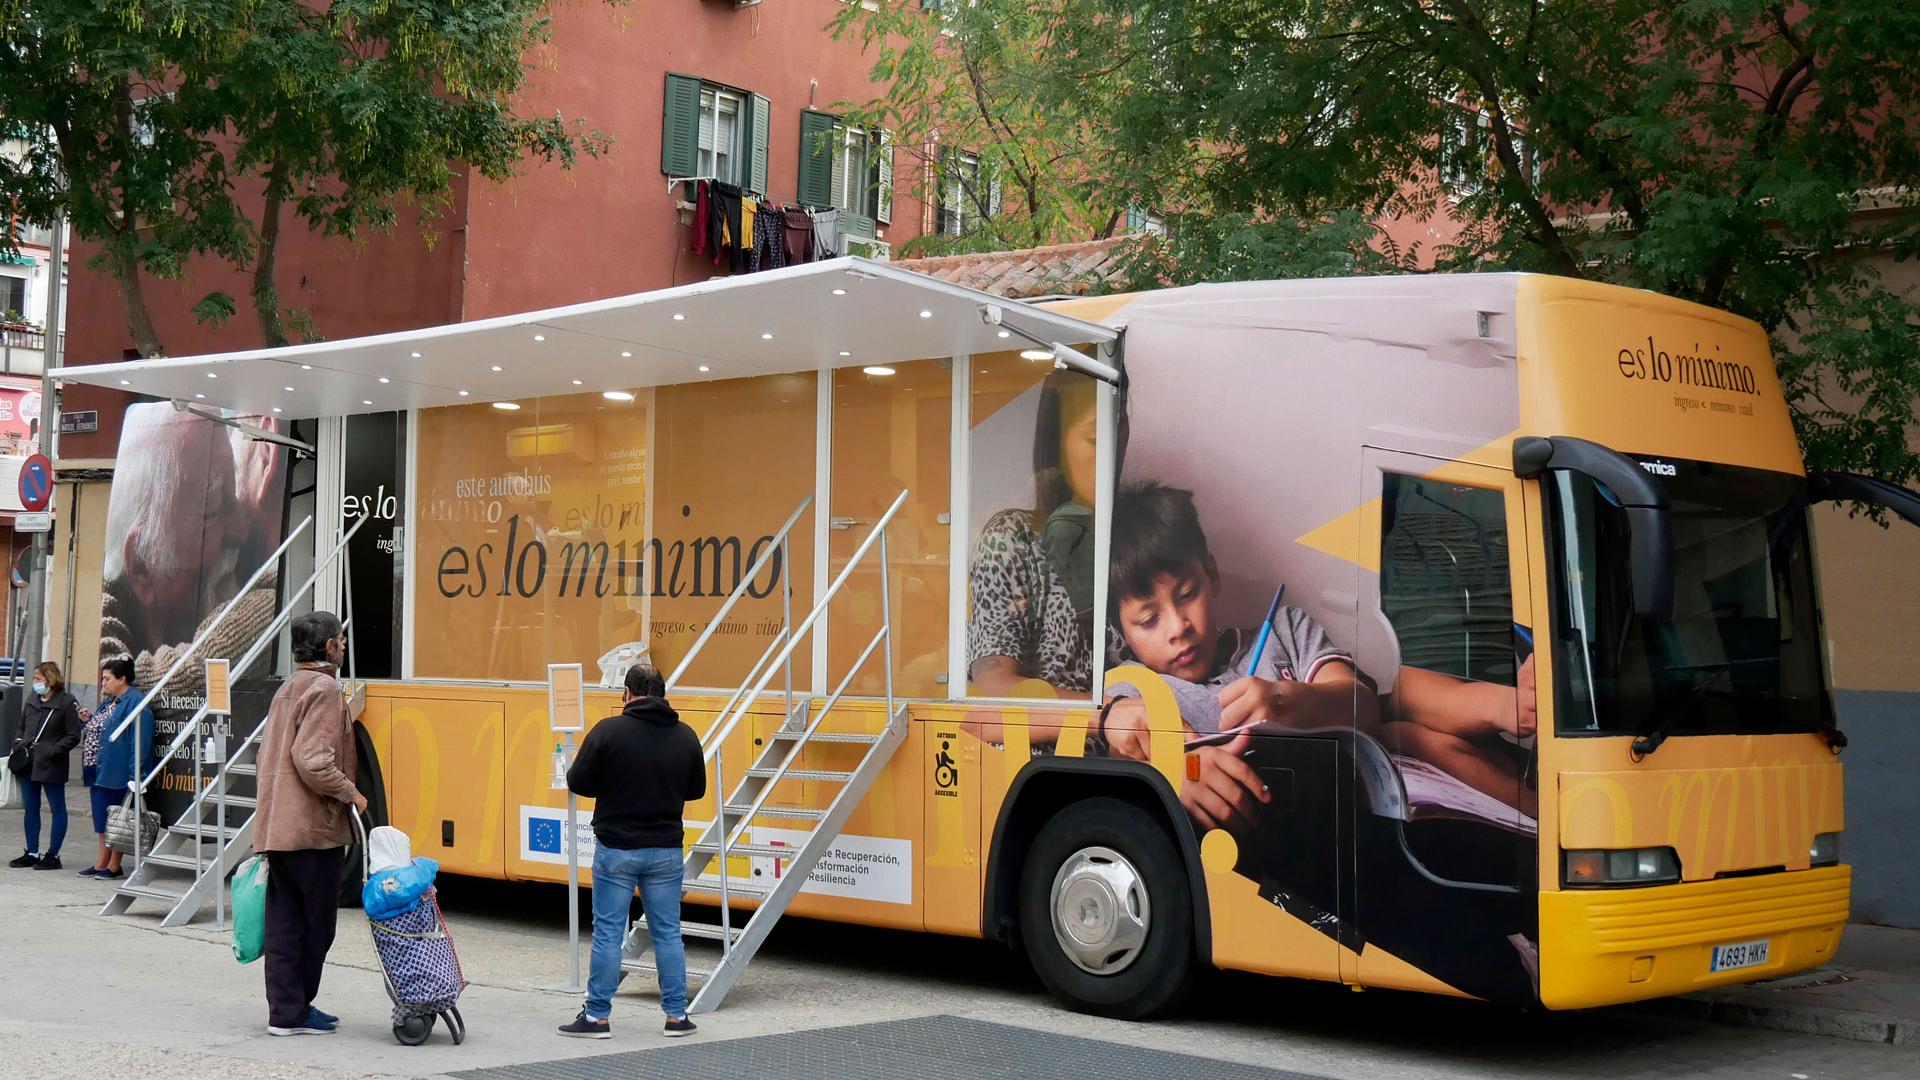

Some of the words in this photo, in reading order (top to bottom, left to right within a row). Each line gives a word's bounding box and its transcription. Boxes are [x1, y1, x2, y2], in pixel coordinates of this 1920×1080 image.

[1617, 348, 1646, 380] es
[1647, 335, 1672, 383] lo
[1675, 343, 1761, 397] mínimo.
[1673, 391, 1700, 412] ingreso
[456, 477, 486, 498] este
[490, 465, 551, 496] autobús
[343, 495, 372, 519] es
[373, 484, 397, 520] lo
[437, 542, 493, 599] es
[496, 513, 547, 599] lo
[755, 616, 785, 636] vital
[160, 689, 169, 709] Si
[162, 765, 174, 790] lo
[835, 850, 900, 866] Recuperación,
[808, 871, 856, 886] Resiliencia
[1719, 946, 1746, 968] 4693
[1747, 942, 1768, 964] HKH
